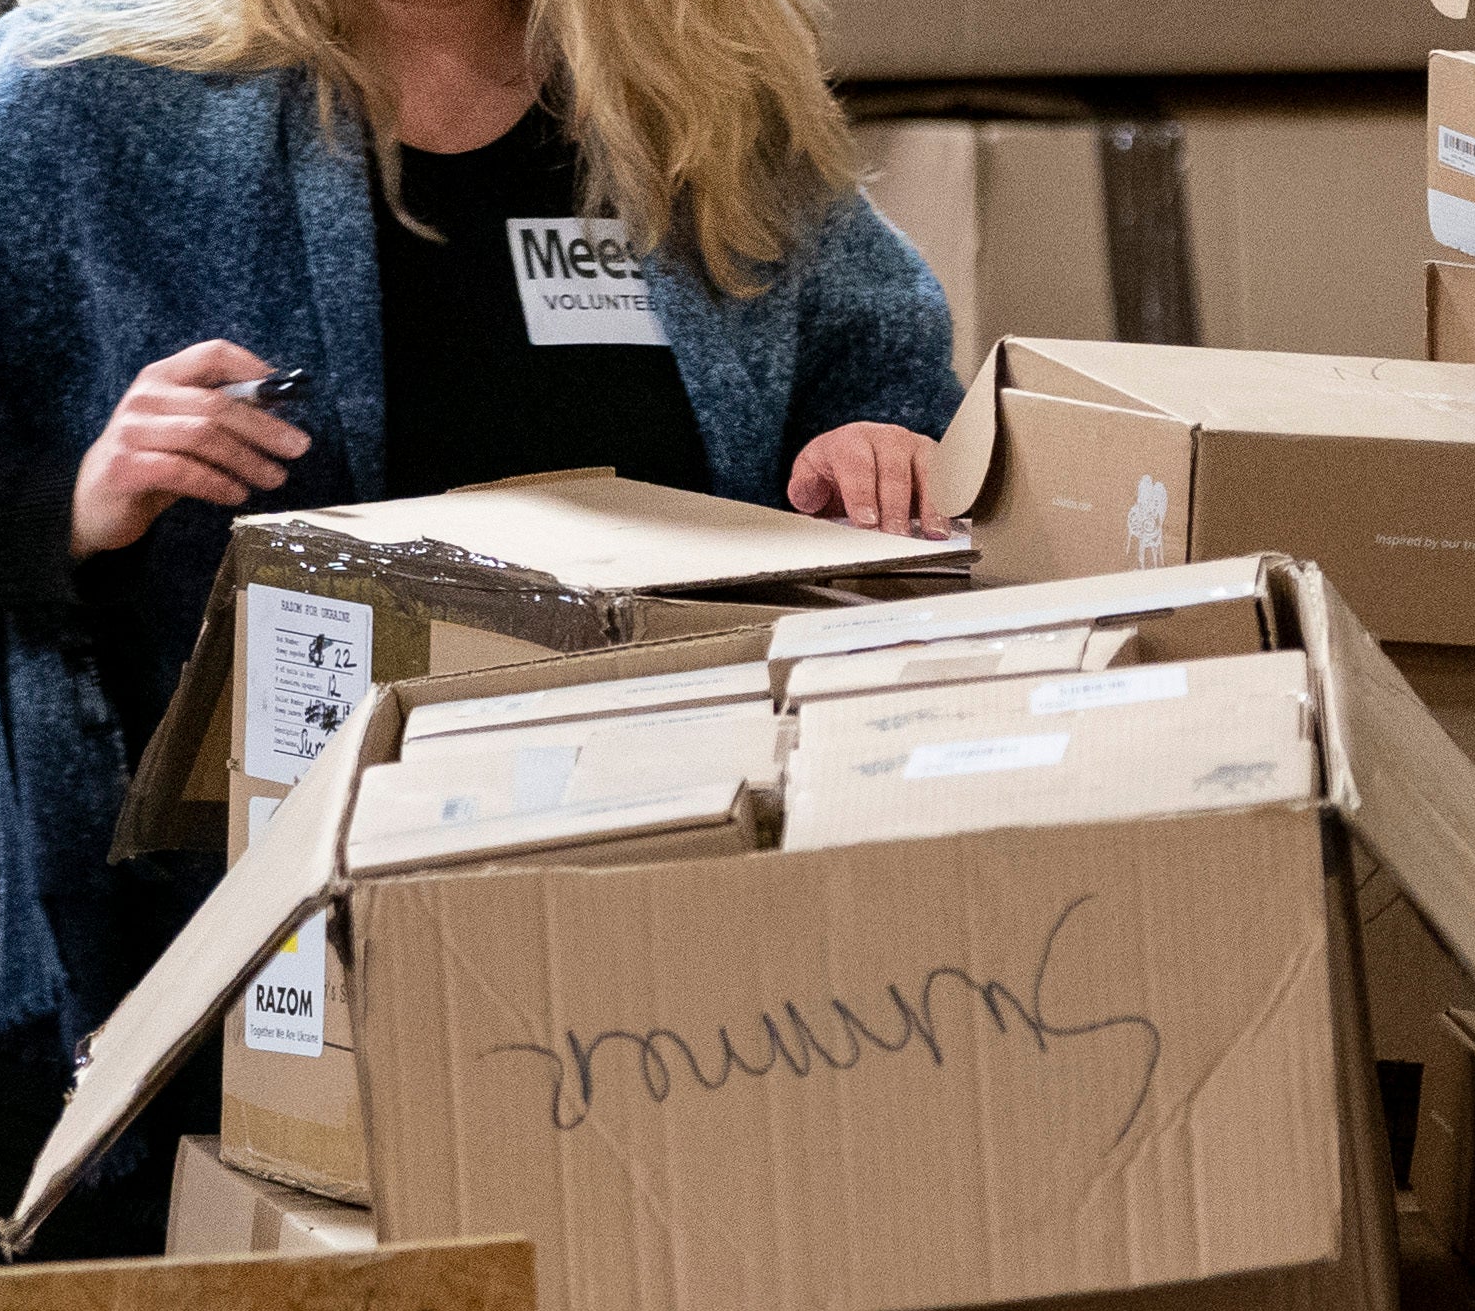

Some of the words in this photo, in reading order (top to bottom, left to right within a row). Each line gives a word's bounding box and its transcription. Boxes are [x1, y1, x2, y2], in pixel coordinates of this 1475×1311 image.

[543, 293, 658, 312] VOLUNTEE
[1375, 533, 1422, 548] Inspired
[1424, 536, 1438, 550] by
[1441, 539, 1460, 549] our
[334, 648, 357, 669] 22
[256, 984, 313, 1018] RAZOM
